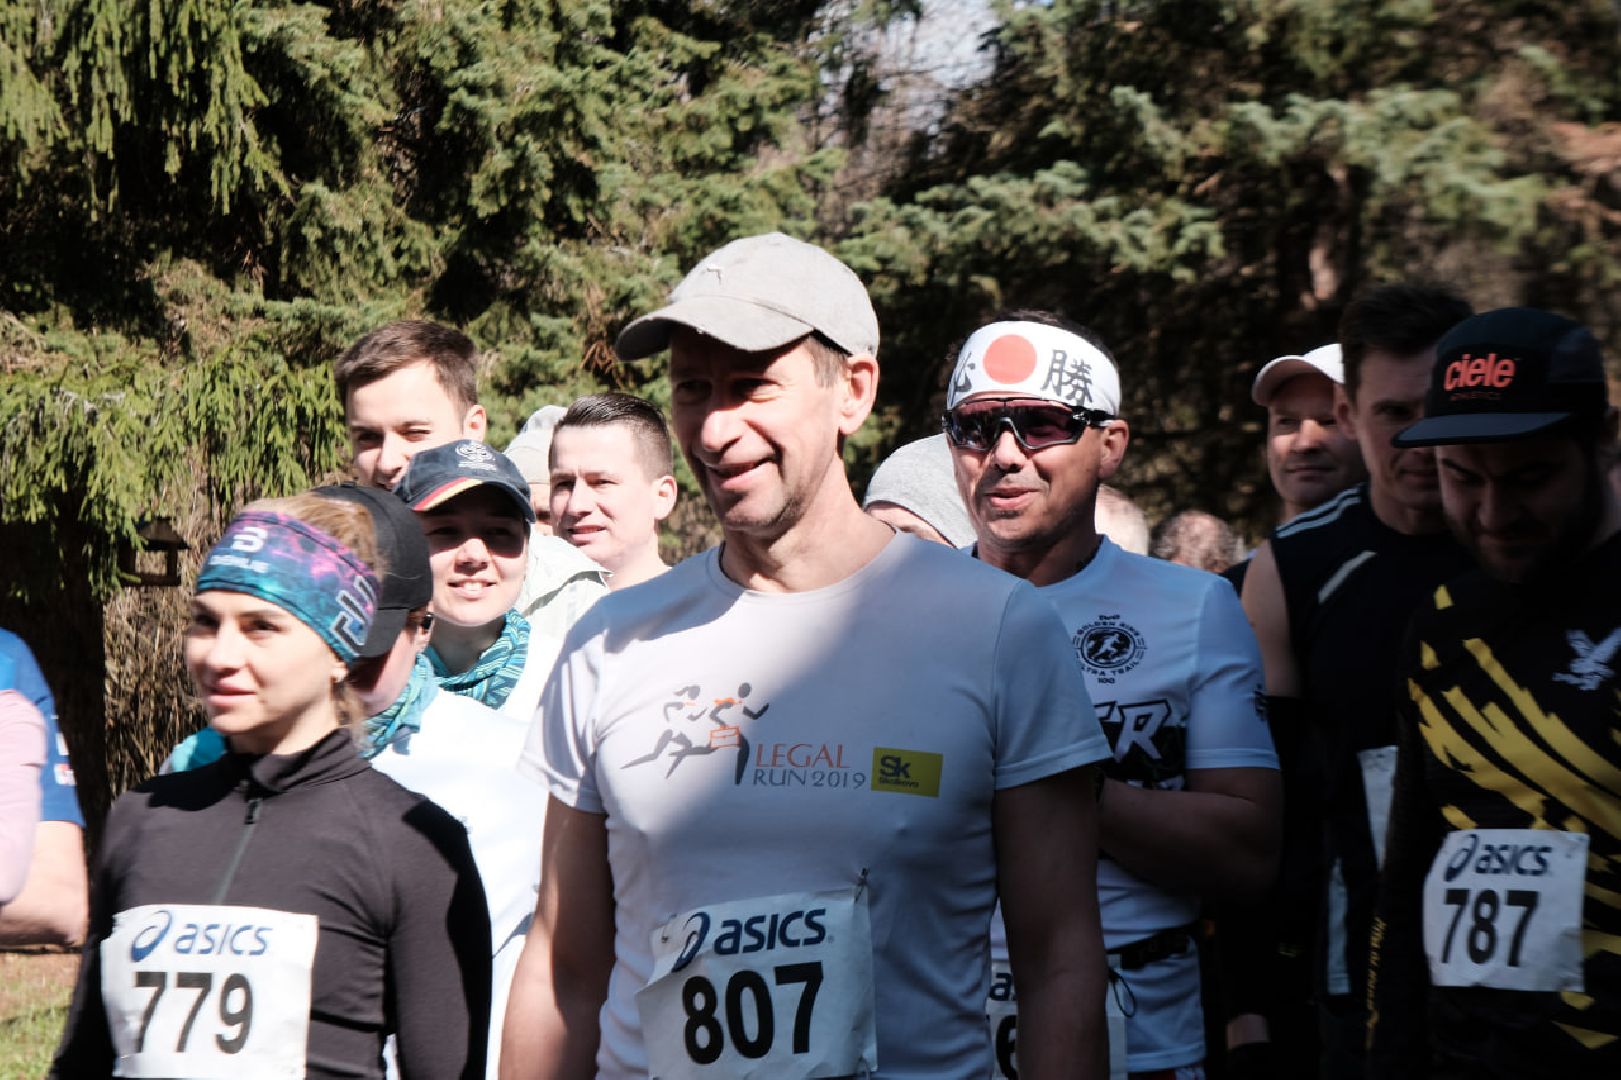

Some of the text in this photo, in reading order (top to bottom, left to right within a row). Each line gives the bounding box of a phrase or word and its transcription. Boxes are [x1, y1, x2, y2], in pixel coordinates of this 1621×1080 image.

[1443, 353, 1517, 391] ciele
[755, 743, 851, 769] LEGAL
[880, 754, 912, 778] Sk
[752, 767, 867, 790] RUN 2019
[1474, 844, 1553, 877] asics
[174, 922, 273, 956] asics
[713, 908, 827, 956] asics
[1441, 887, 1541, 968] 787
[133, 970, 254, 1055] 779
[681, 960, 824, 1066] 807
